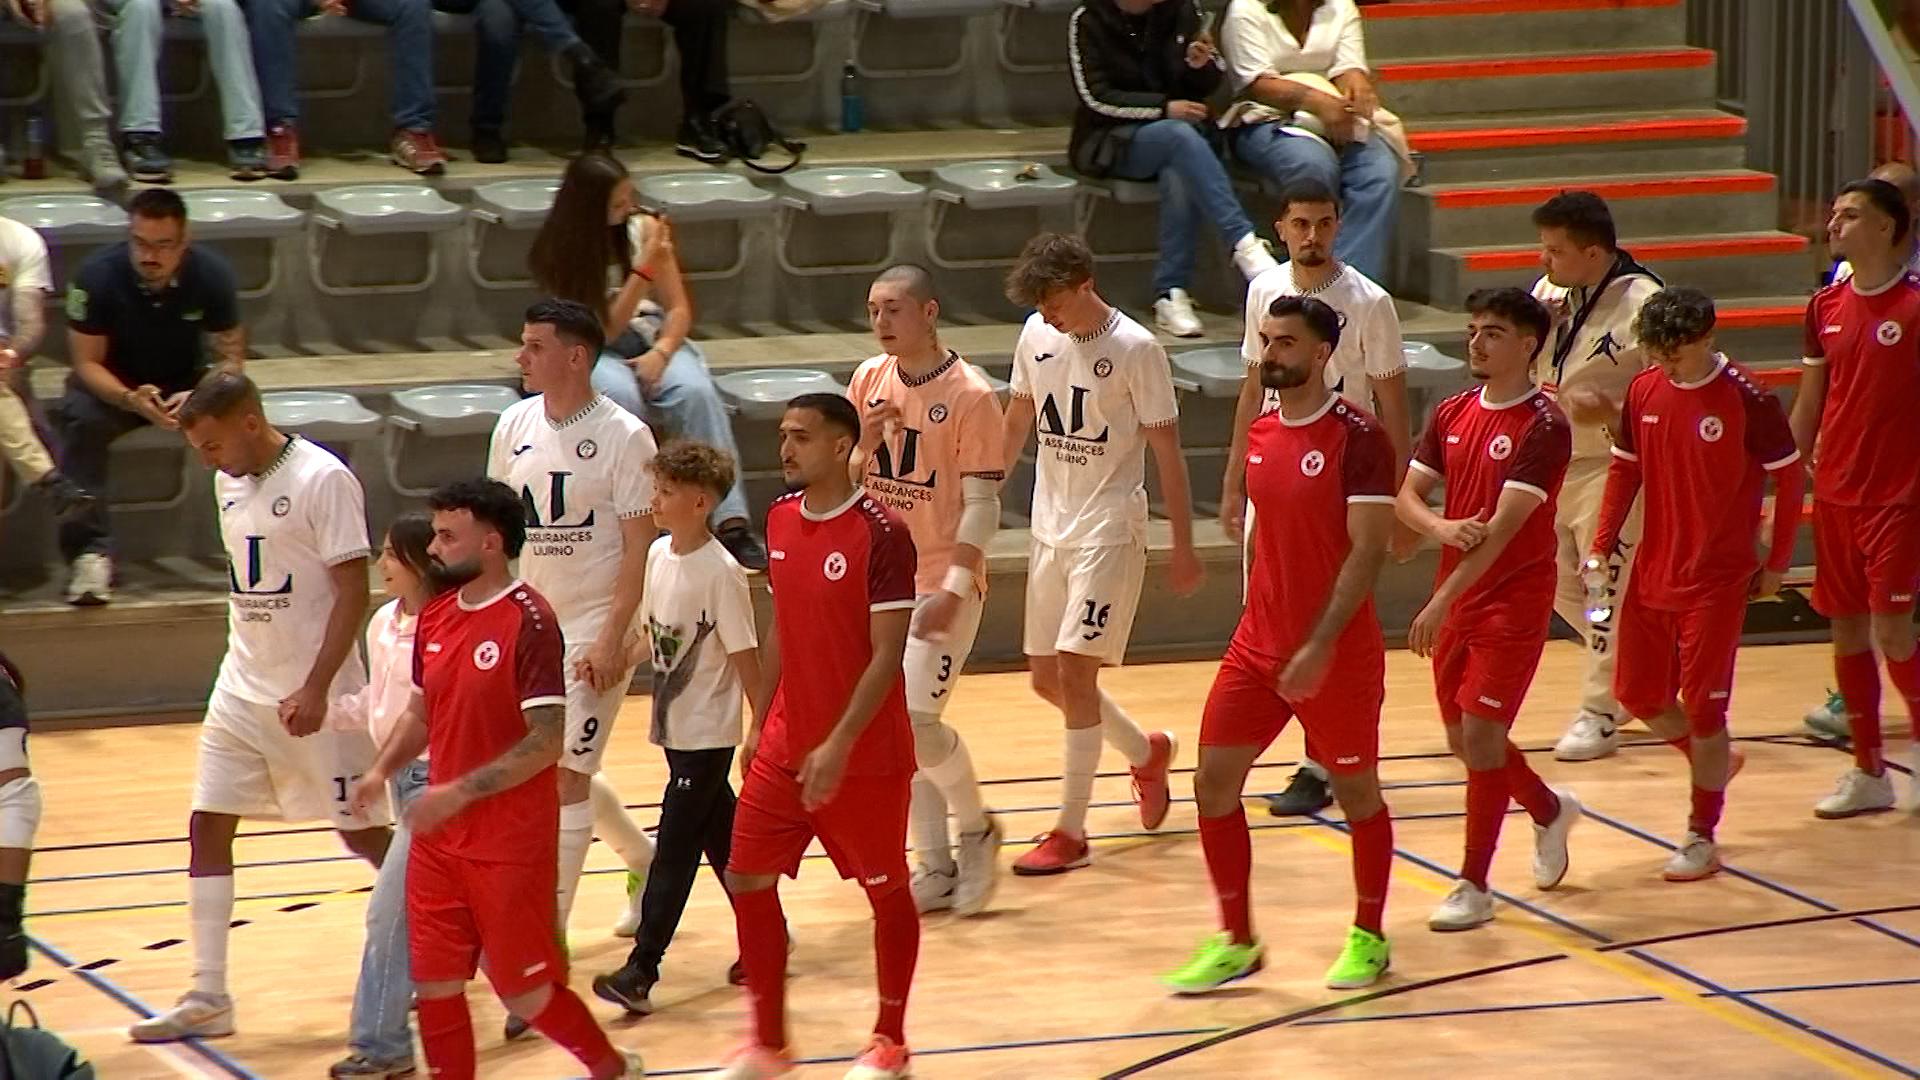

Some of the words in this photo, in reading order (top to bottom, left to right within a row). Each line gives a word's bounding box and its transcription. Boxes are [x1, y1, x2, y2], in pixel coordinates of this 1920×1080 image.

[1082, 600, 1111, 628] 16
[937, 655, 952, 681] 3
[580, 717, 598, 742] 9
